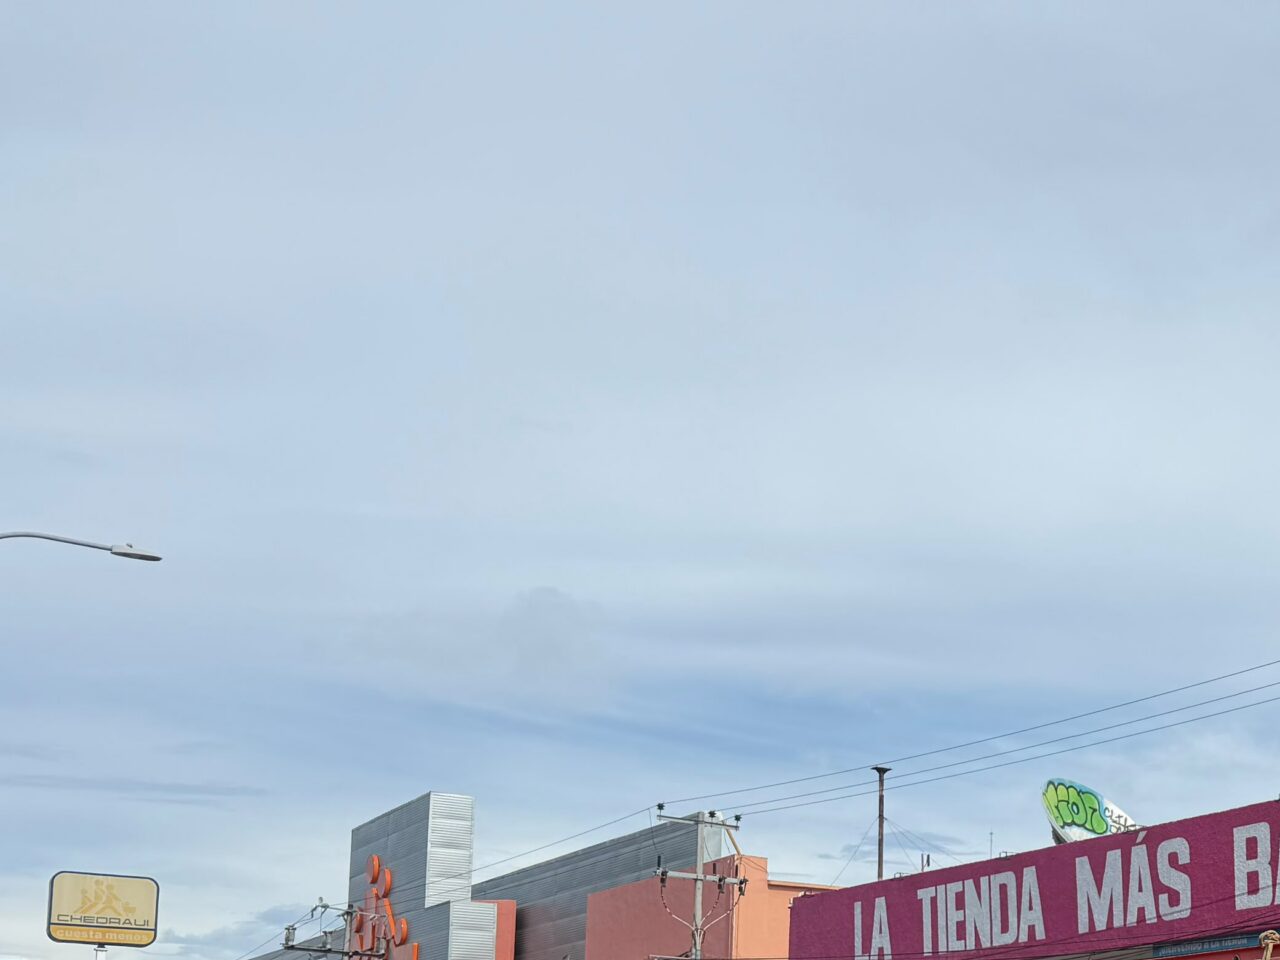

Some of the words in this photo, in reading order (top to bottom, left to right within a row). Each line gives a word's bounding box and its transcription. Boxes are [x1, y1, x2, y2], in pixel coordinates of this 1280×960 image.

[917, 865, 1045, 956] TIENDA
[1075, 829, 1191, 933] MÁS
[57, 914, 149, 927] CHEDRAUI
[57, 929, 103, 939] cuesta
[106, 932, 148, 941] menos
